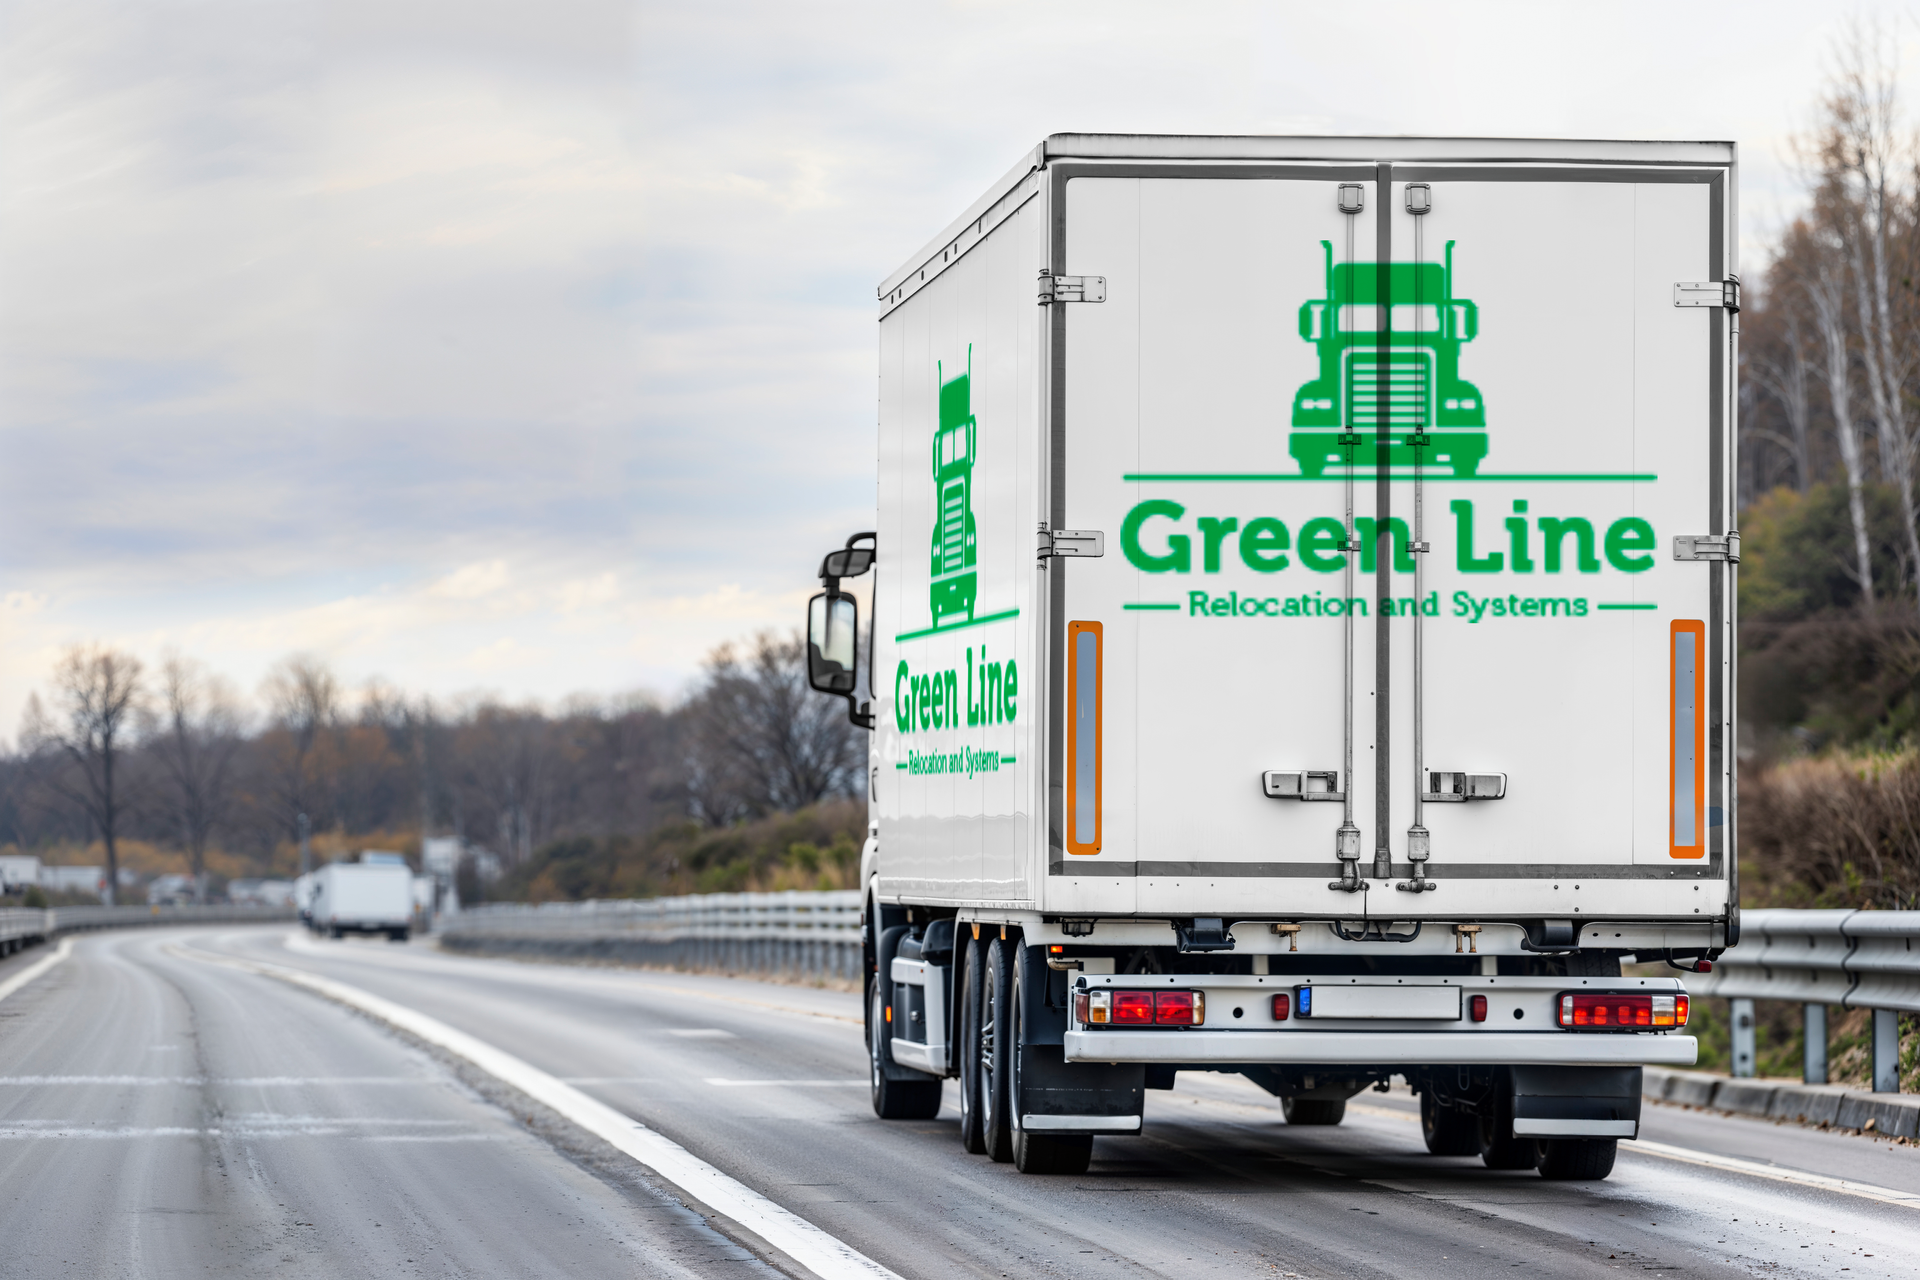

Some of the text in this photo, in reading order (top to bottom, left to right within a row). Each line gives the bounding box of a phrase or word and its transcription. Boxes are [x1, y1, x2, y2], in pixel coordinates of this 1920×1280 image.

[1120, 498, 1658, 575] Green Line
[1188, 590, 1589, 624] Relocation and Systems
[895, 644, 1018, 735] Green Line
[908, 745, 1000, 780] Relocation and Systems
